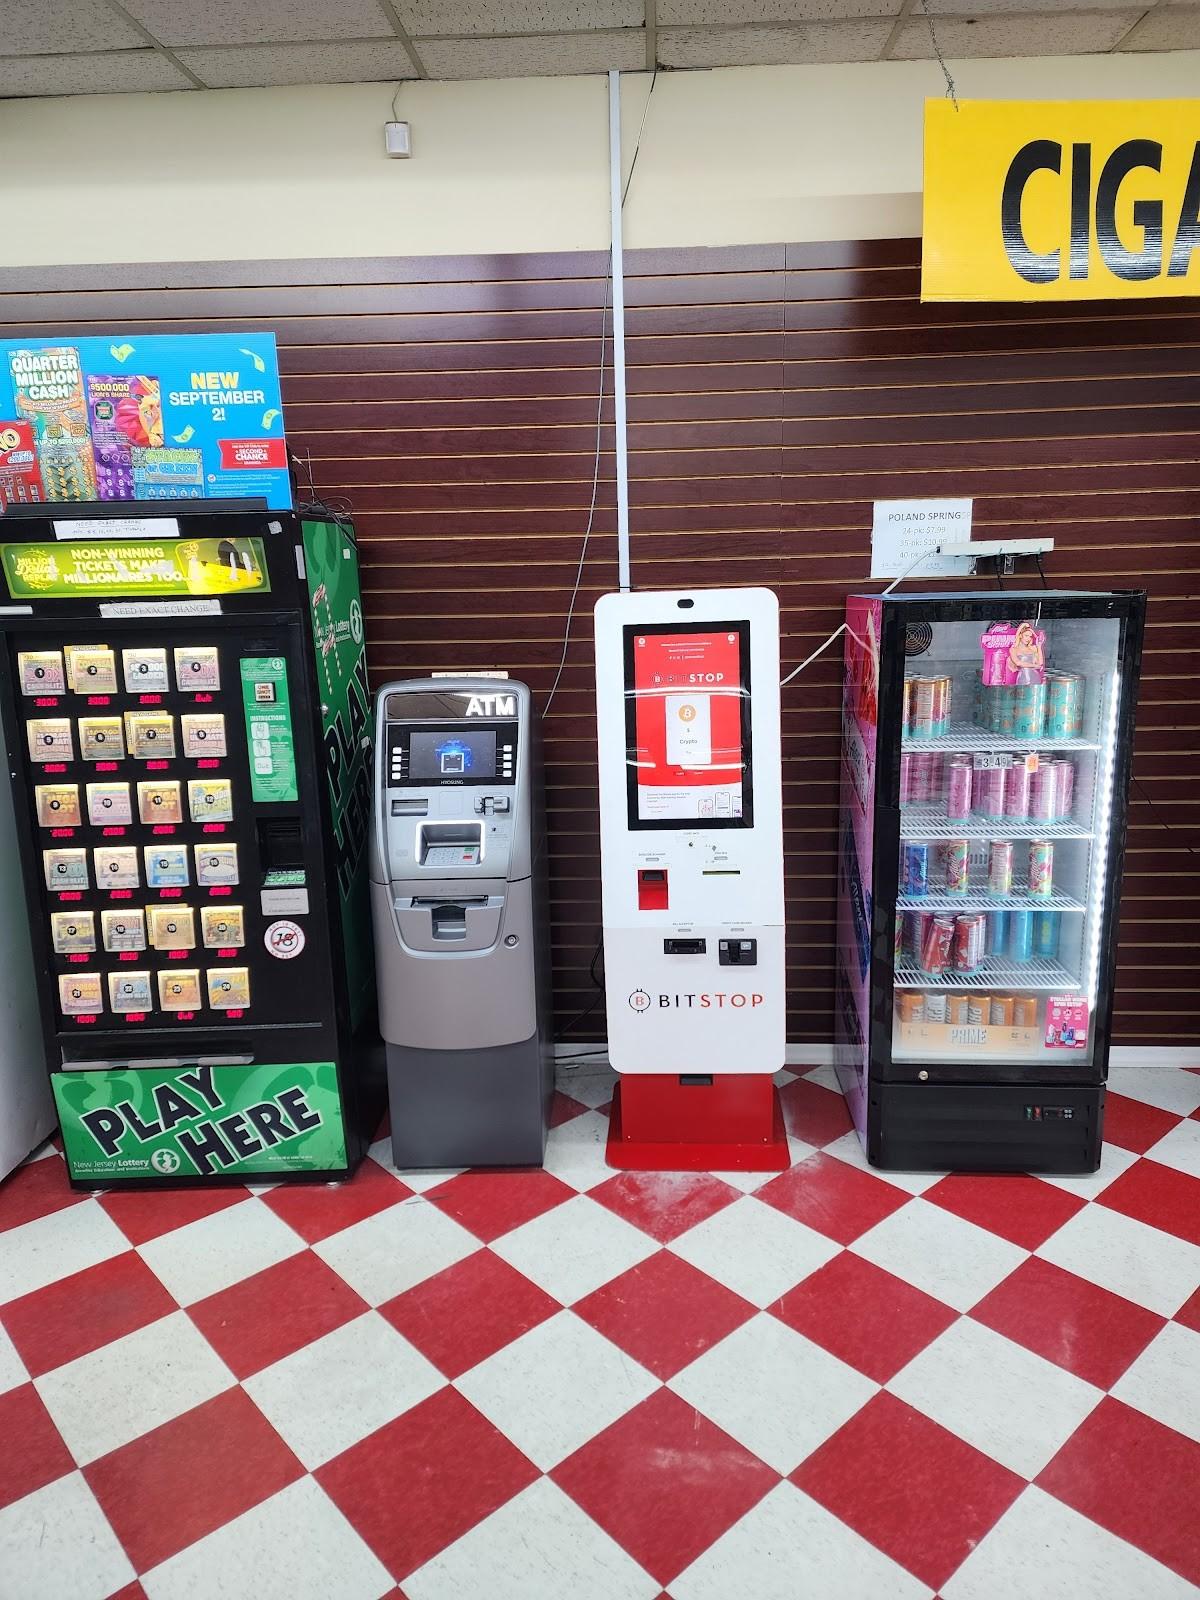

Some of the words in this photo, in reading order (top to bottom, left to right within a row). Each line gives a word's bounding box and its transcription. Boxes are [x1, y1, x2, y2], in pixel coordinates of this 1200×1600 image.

[12, 355, 78, 373] QUARTER
[15, 370, 79, 387] MILLION
[191, 371, 239, 389] NEW
[169, 390, 265, 406] SEPTEMBER
[212, 407, 226, 421] 2!
[235, 452, 268, 461] CHANCE
[888, 513, 926, 522] POLAND
[927, 511, 961, 520] SPRING
[71, 548, 165, 560] NON-WINNING
[73, 560, 128, 572] TICKETS
[63, 571, 154, 584] MILLIONAIRES
[112, 606, 137, 615] NEED
[139, 605, 167, 613] EXACT
[170, 603, 209, 612] CHANGE
[466, 696, 514, 717] ATM
[659, 994, 764, 1008] BITSTOP
[951, 1029, 987, 1045] PRIME
[80, 1067, 225, 1158] PLAY
[174, 1085, 324, 1176] HERE
[93, 1160, 117, 1169] Jersey
[118, 1159, 150, 1168] Lottery
